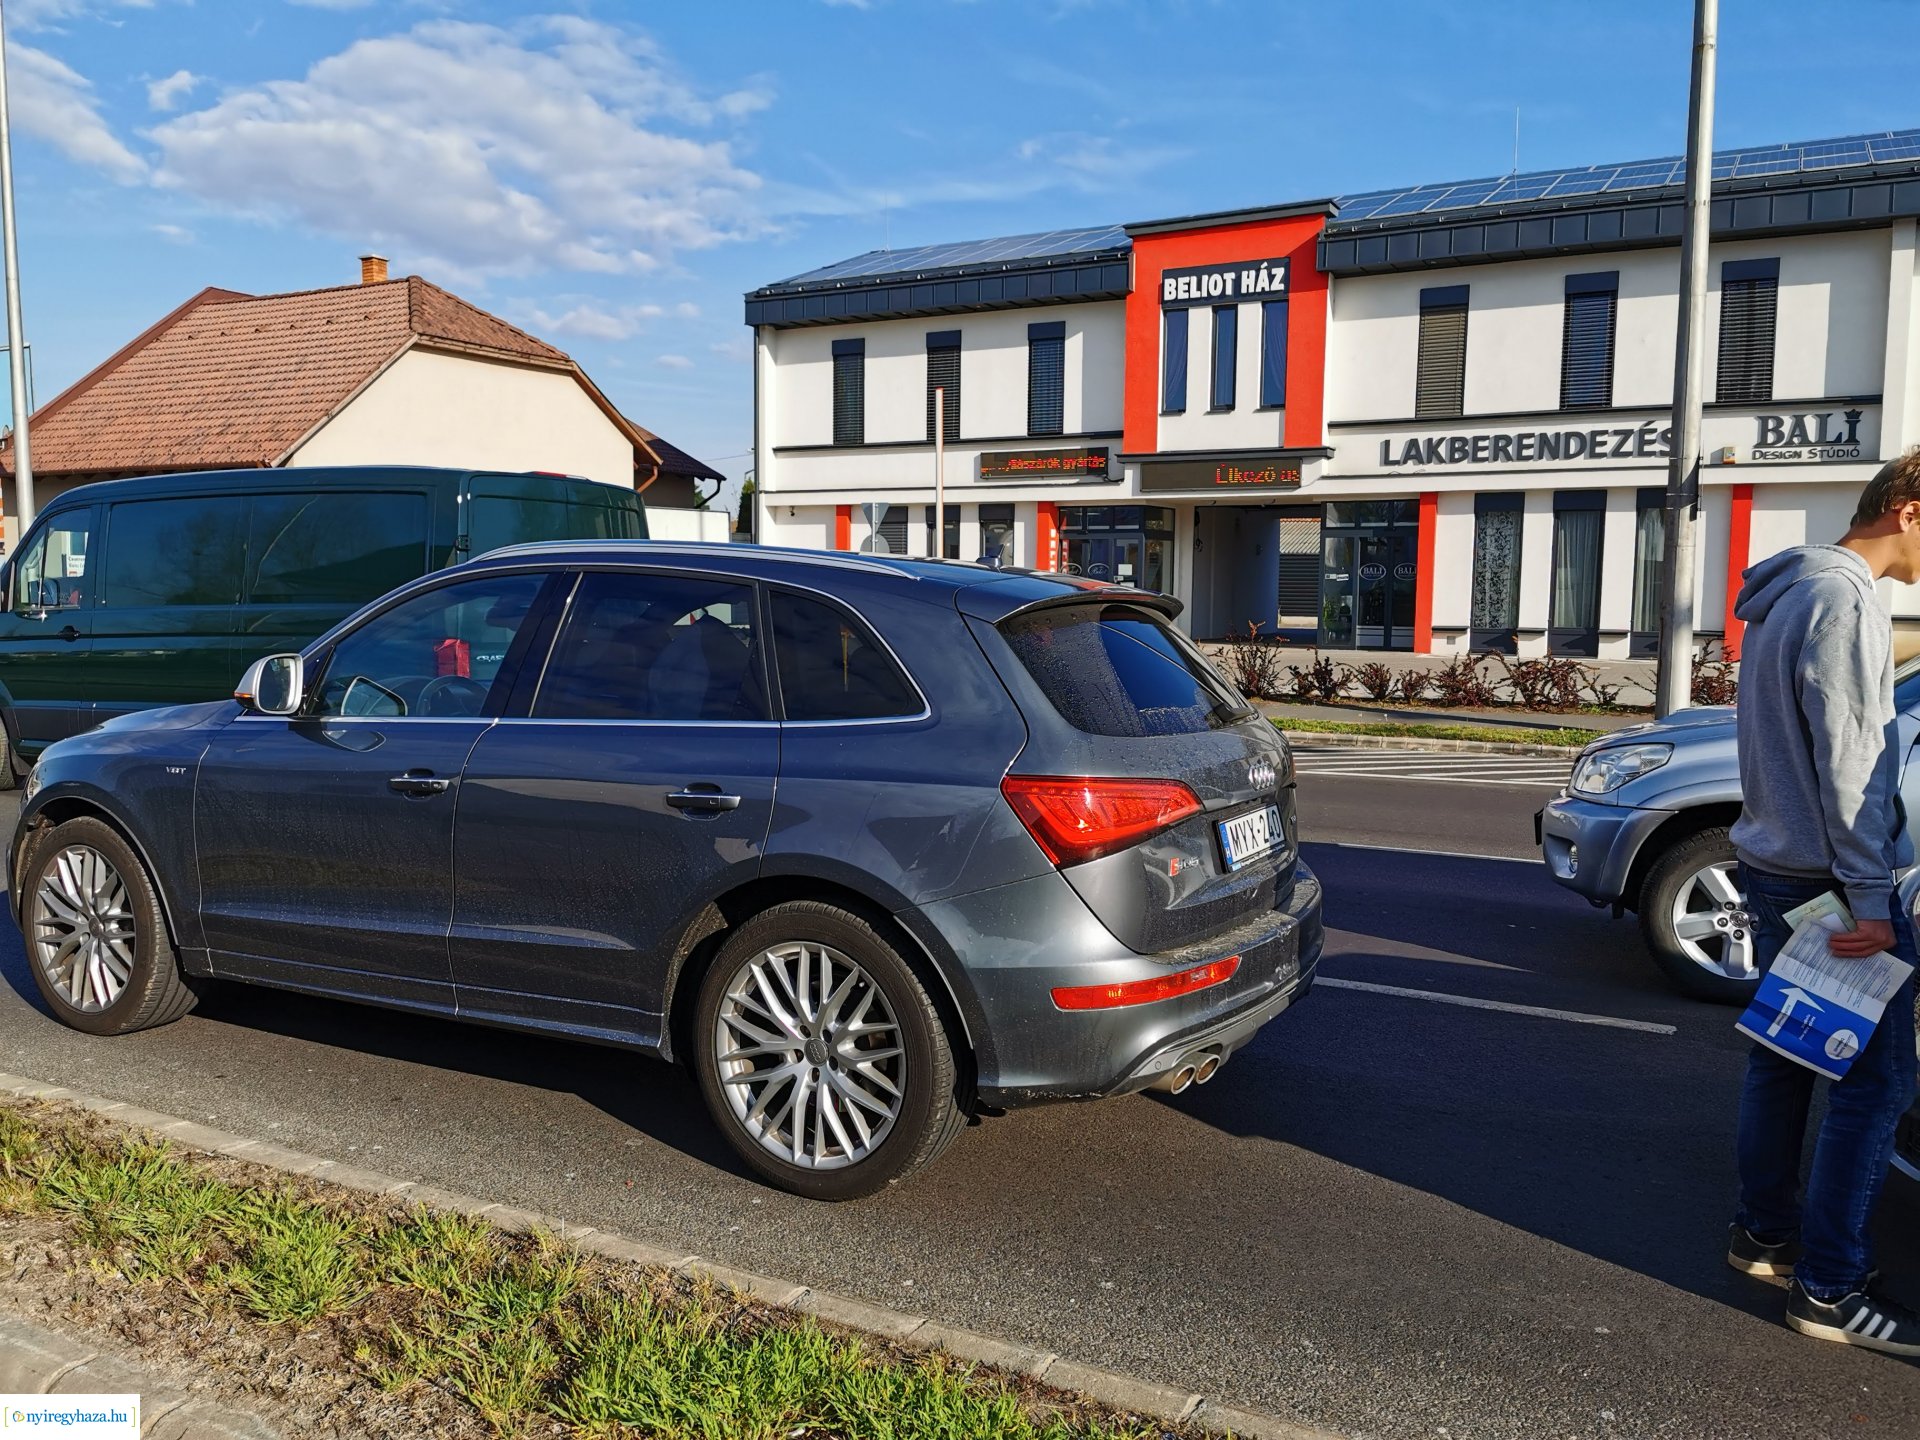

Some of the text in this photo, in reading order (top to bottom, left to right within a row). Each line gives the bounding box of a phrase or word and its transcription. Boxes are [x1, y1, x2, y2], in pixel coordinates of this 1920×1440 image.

[1164, 261, 1285, 301] BELIOT HÁZ
[1752, 409, 1863, 449] BALI
[1752, 449, 1802, 461] DESIGN
[1229, 809, 1282, 857] MYX-240
